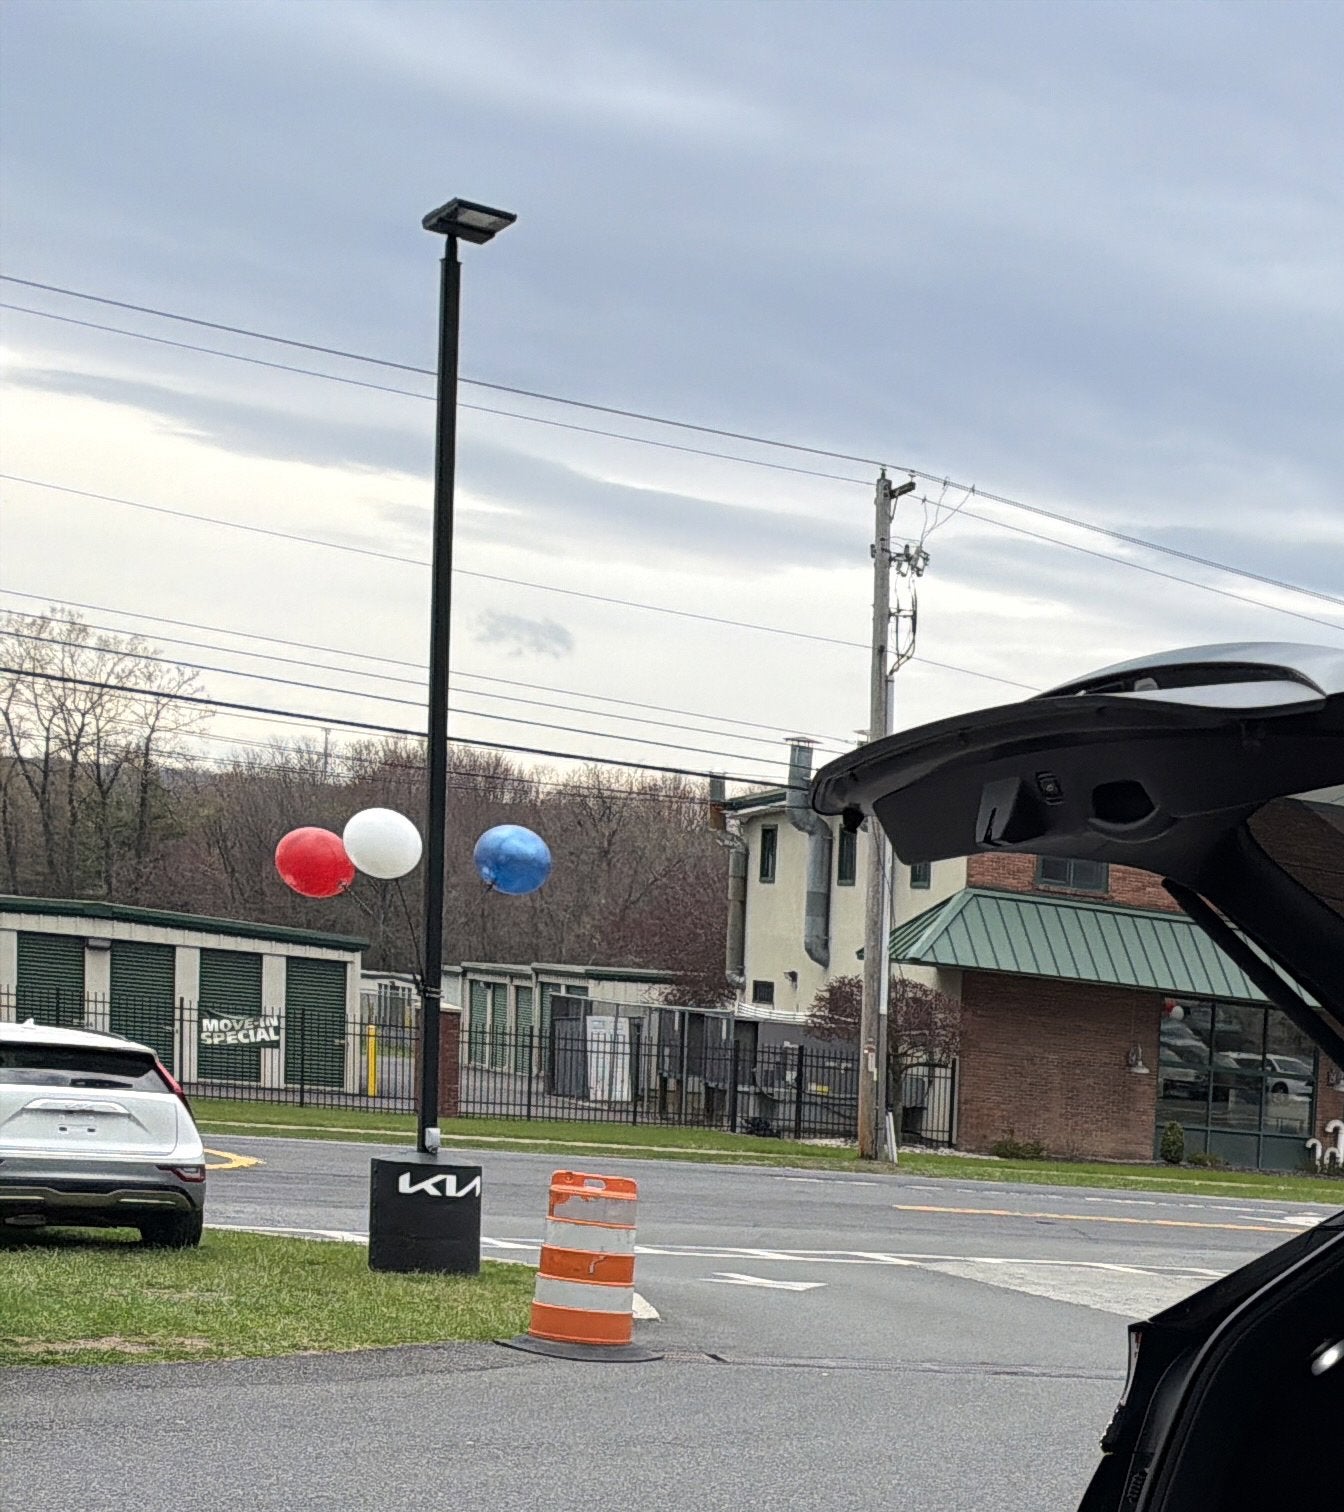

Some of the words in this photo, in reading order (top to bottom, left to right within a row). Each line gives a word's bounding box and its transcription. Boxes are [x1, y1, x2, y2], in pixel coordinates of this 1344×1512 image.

[202, 1015, 279, 1031] MOVE-IN
[200, 1027, 280, 1044] SPECIAL
[398, 1171, 481, 1197] KIA
